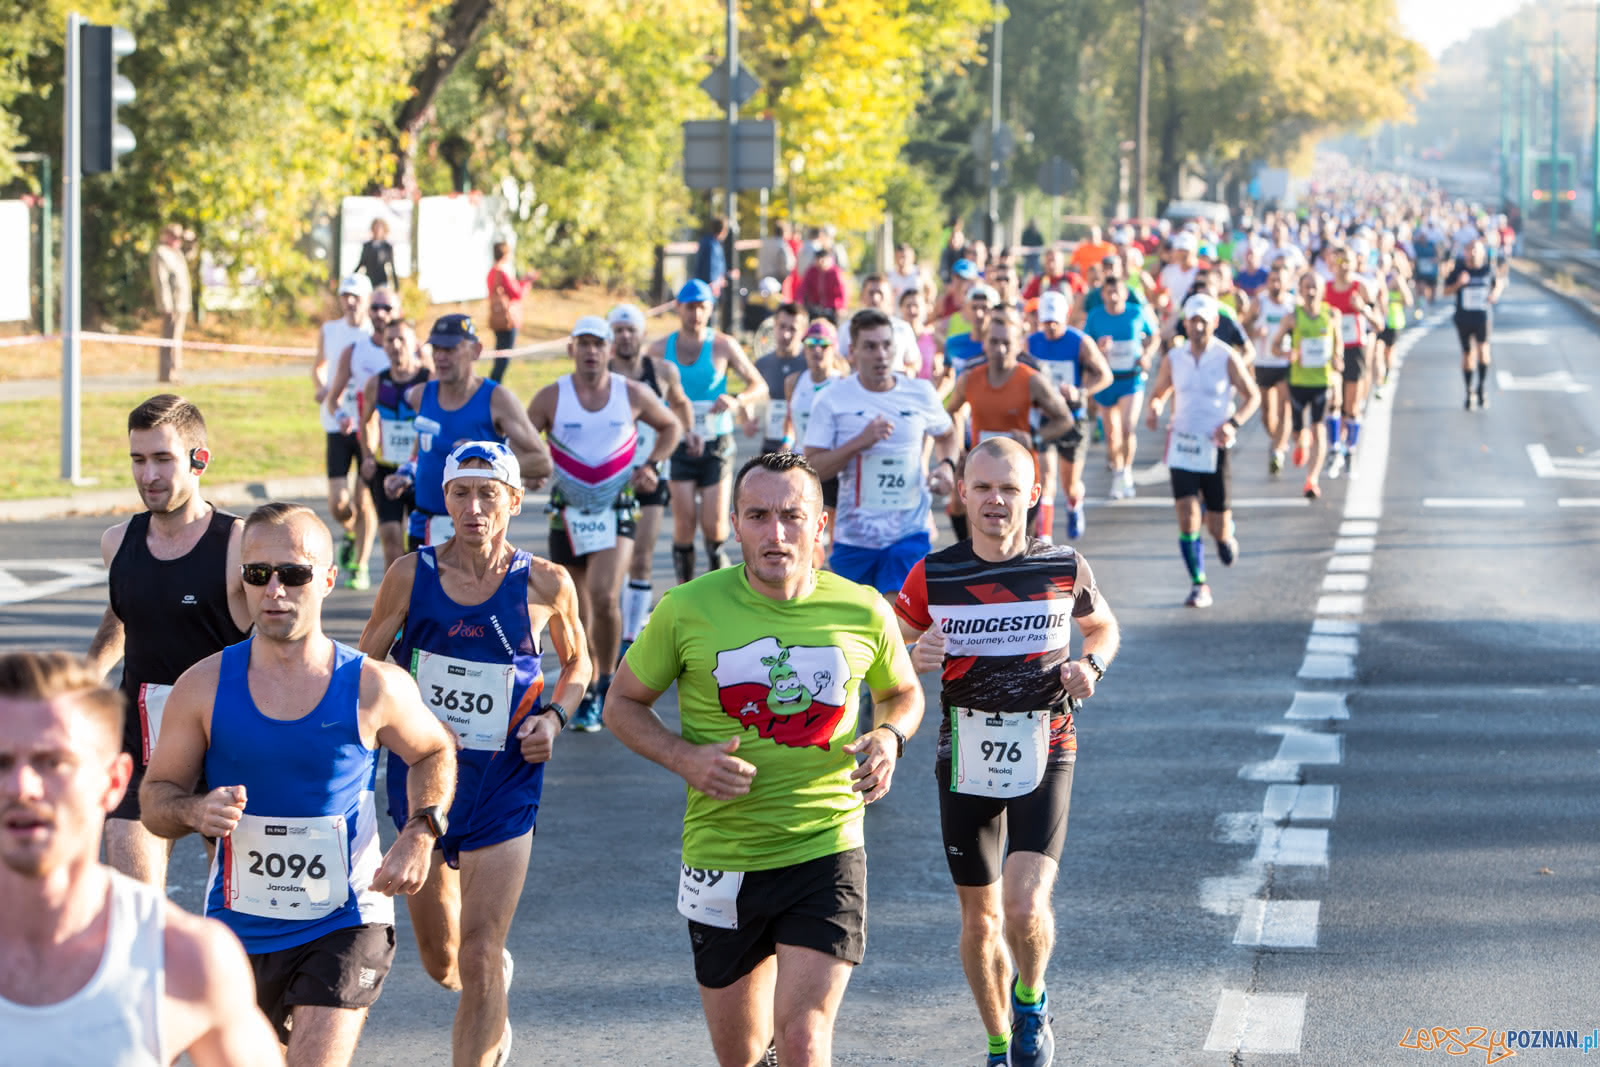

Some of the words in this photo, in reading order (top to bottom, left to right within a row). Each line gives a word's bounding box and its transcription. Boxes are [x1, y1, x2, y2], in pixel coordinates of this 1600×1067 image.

[877, 474, 905, 488] 726
[941, 613, 1066, 635] BRIDGESTONE
[1007, 634, 1025, 643] Our
[430, 684, 494, 715] 3630
[980, 740, 1022, 763] 976
[248, 850, 326, 880] 2096
